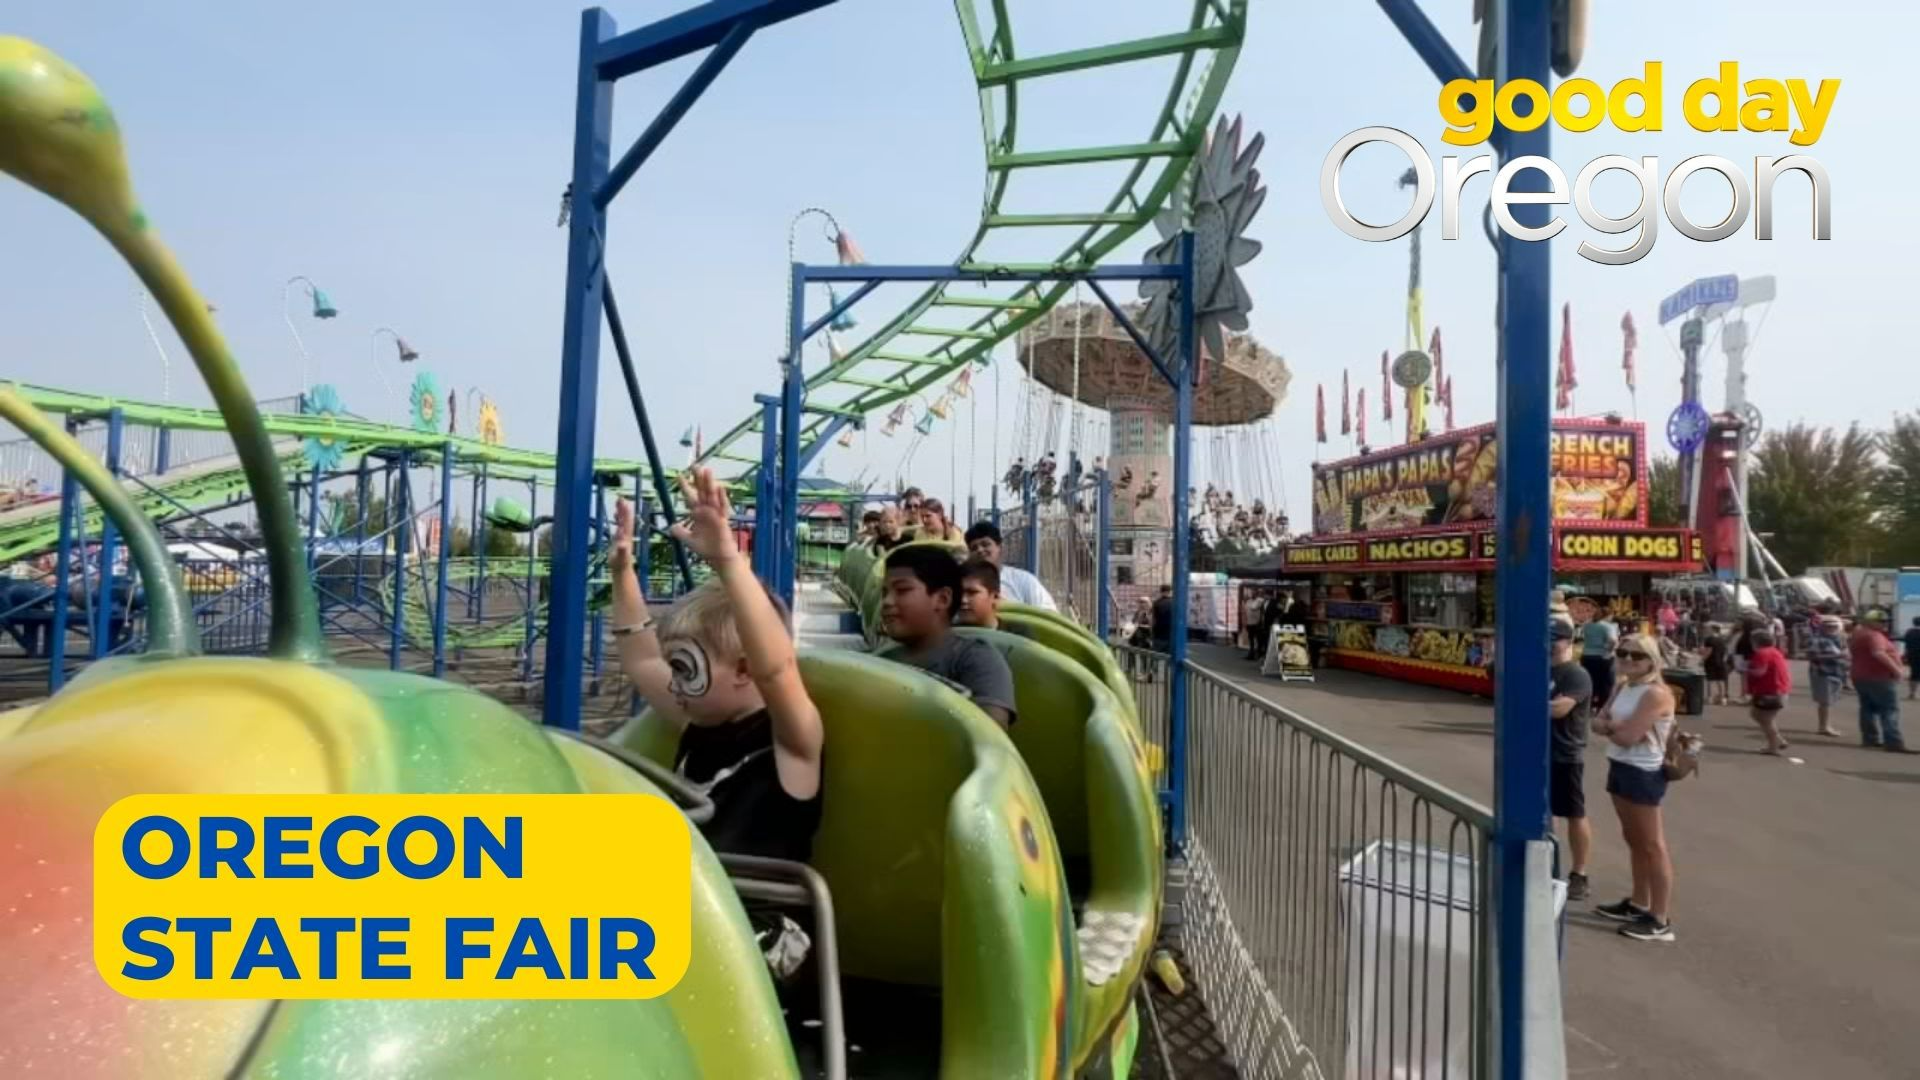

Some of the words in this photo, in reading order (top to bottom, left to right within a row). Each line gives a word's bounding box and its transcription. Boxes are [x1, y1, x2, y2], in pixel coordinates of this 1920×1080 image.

[1551, 432, 1631, 456] RENCH
[1370, 538, 1465, 561] NACHOS
[1562, 534, 1618, 556] CORN
[1624, 536, 1678, 557] DOGS
